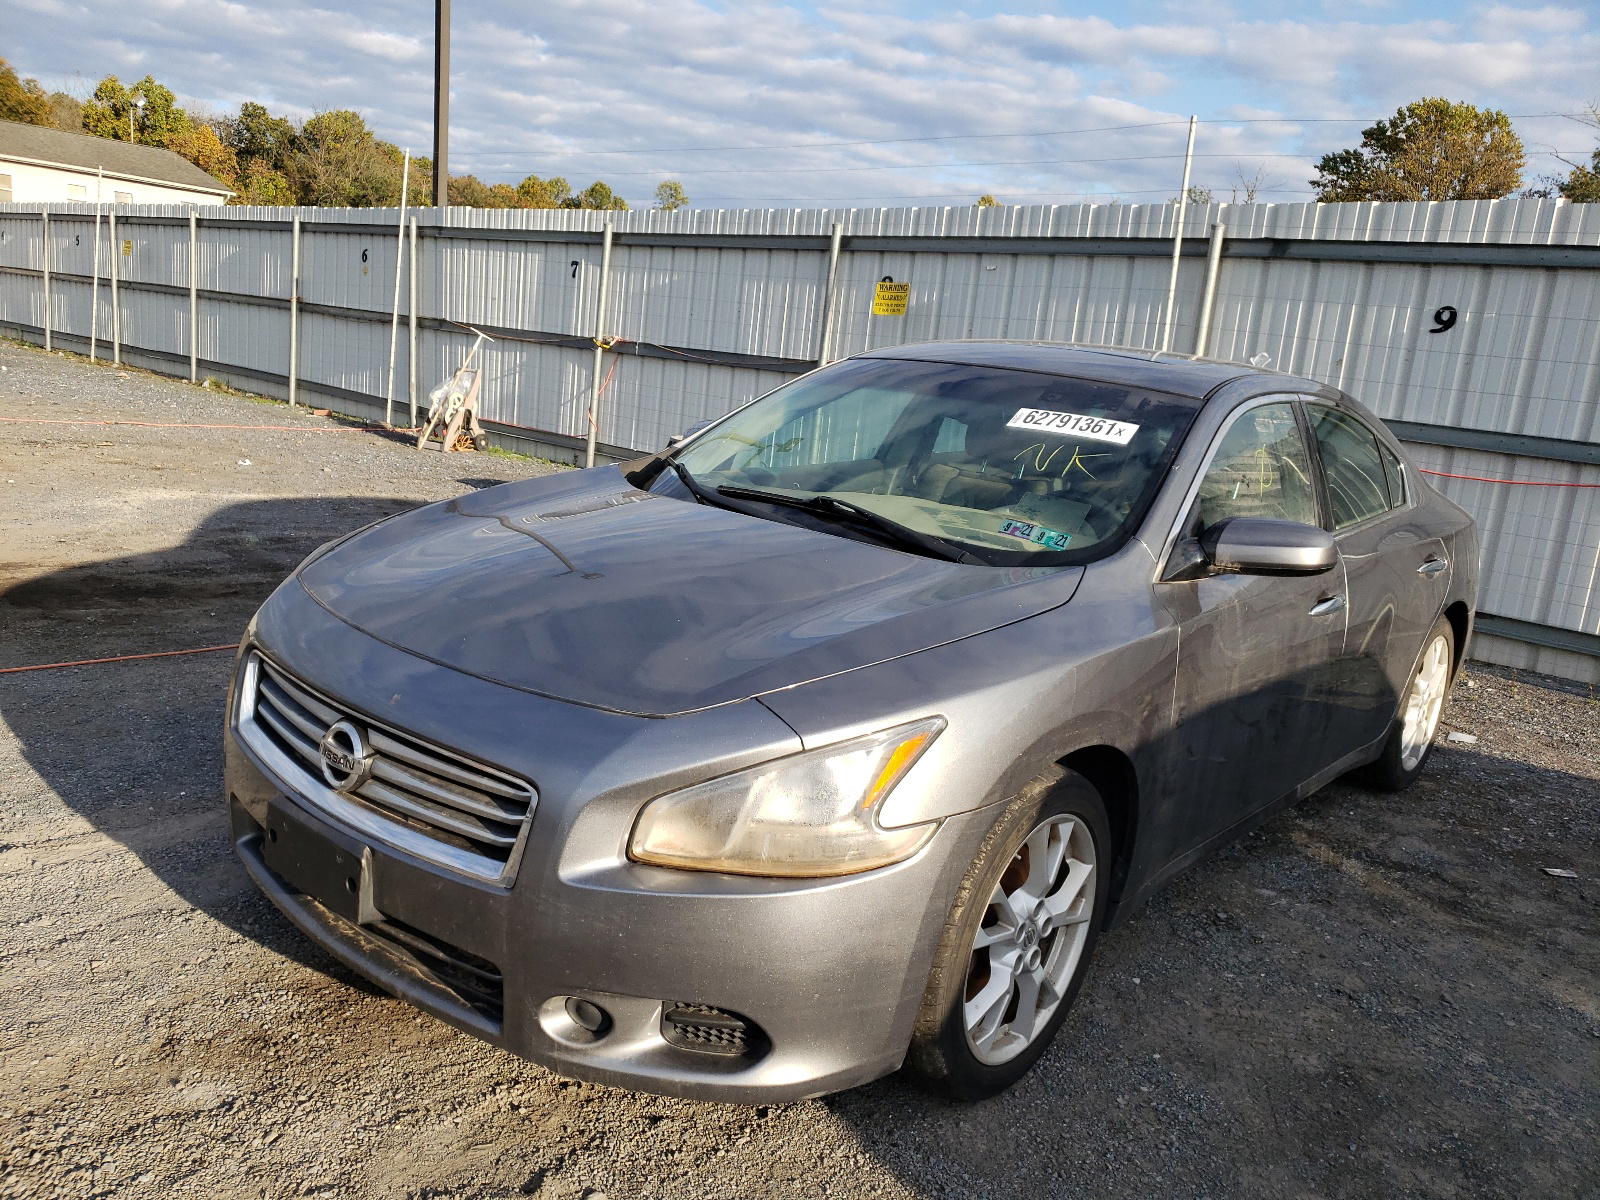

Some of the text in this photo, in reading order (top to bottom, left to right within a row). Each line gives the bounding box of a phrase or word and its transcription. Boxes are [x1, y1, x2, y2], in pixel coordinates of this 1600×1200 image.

[75, 235, 80, 246] 5
[361, 248, 368, 263] 6
[570, 260, 579, 279] 7
[879, 283, 908, 292] WARNING
[1428, 305, 1458, 334] 9
[1021, 524, 1035, 537] 21
[1056, 534, 1069, 548] 21
